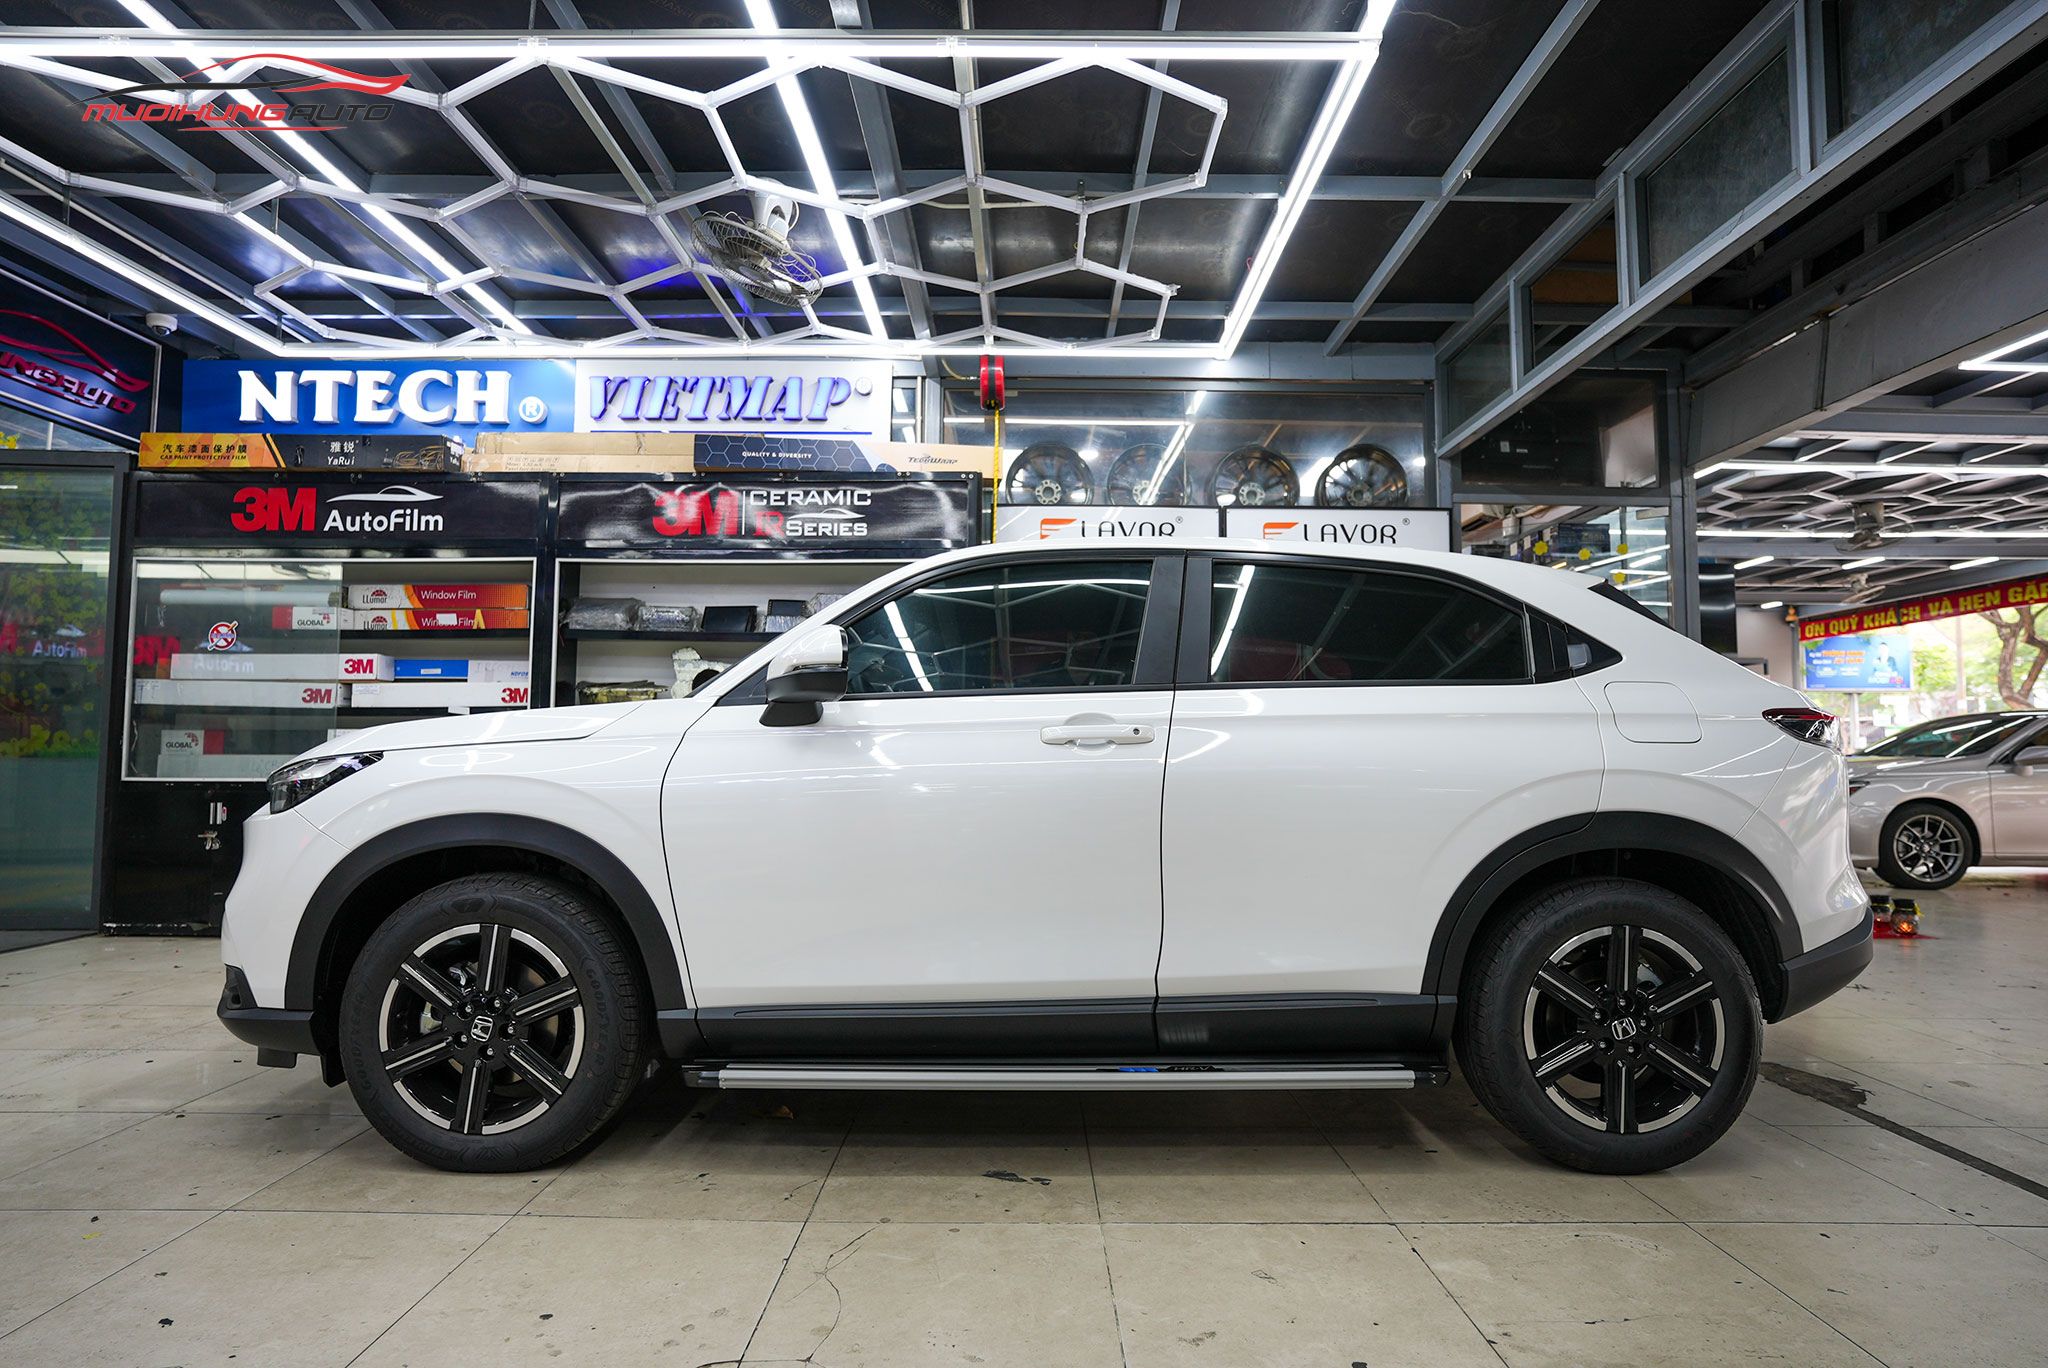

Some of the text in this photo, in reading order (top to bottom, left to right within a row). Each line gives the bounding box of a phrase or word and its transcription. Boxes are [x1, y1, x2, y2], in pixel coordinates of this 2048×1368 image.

[238, 369, 513, 425] NTECH
[589, 376, 851, 421] VIETMAP
[327, 456, 355, 465] YaRui
[750, 490, 871, 506] CERAMIC
[231, 487, 443, 532] 3M AutoFilm
[652, 490, 739, 536] 3M
[785, 520, 868, 536] SERIES
[420, 590, 477, 599] Window Film
[344, 658, 374, 674] 3M
[302, 688, 332, 704] 3M
[501, 687, 529, 703] 3M
